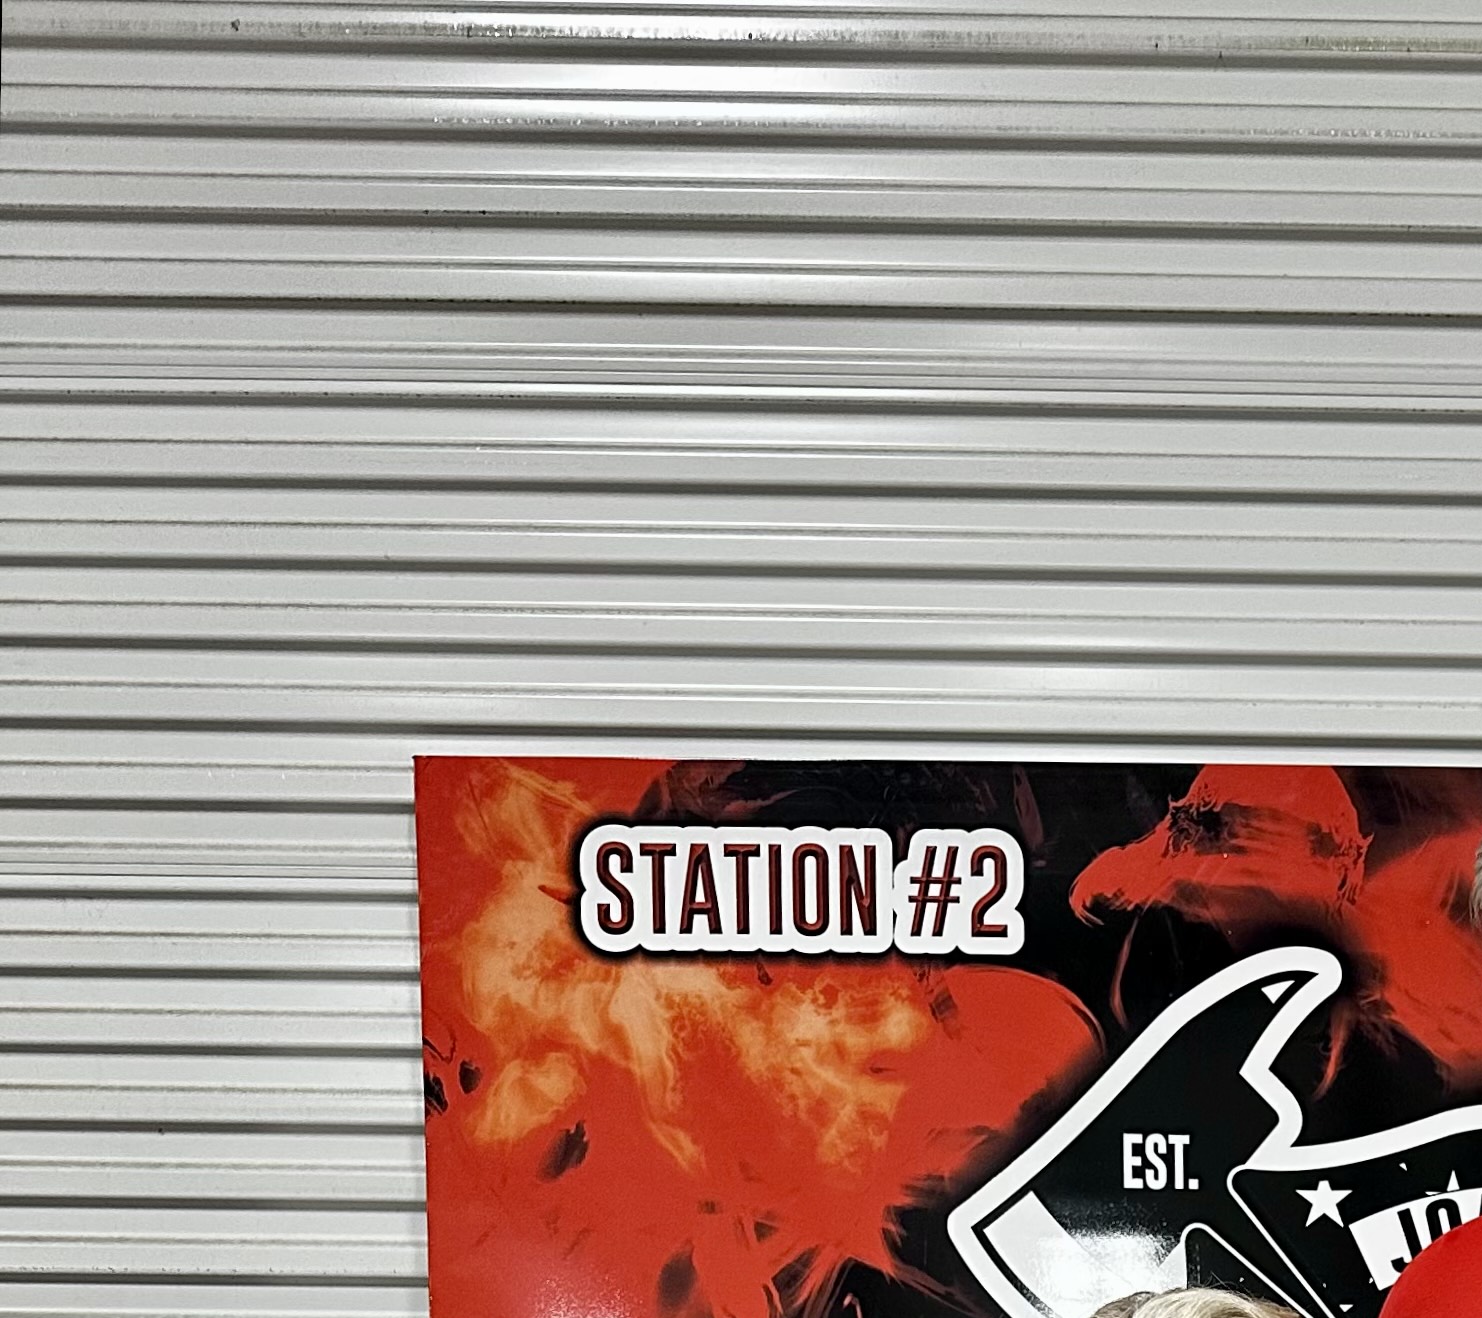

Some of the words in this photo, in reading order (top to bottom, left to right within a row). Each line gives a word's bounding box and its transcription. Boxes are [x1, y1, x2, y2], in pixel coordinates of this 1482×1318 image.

[596, 841, 877, 936] STATION
[908, 845, 1008, 937] #2
[1123, 1133, 1199, 1190] EST.
